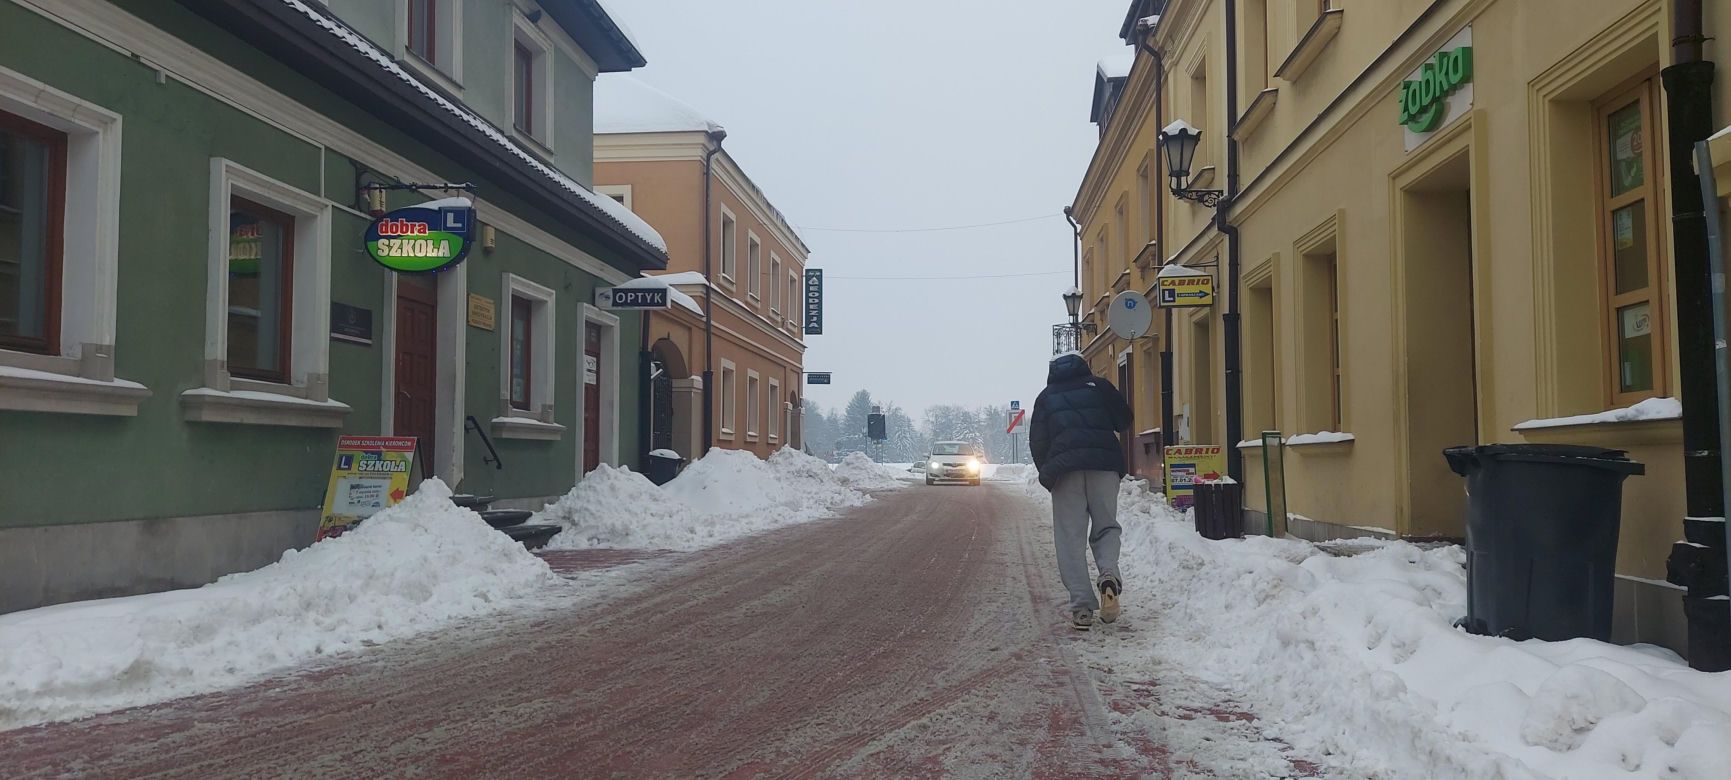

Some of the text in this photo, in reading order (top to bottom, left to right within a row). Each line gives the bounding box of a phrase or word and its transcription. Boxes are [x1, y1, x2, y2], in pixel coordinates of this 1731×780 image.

[446, 212, 463, 228] L
[378, 218, 429, 236] dobra
[377, 237, 451, 258] SZKOŁA
[1160, 278, 1210, 287] CABRIO
[615, 292, 664, 305] OPTYK
[1164, 290, 1174, 301] L
[1165, 447, 1221, 456] CABRIO
[340, 456, 349, 469] L
[359, 460, 406, 472] SZKOŁA
